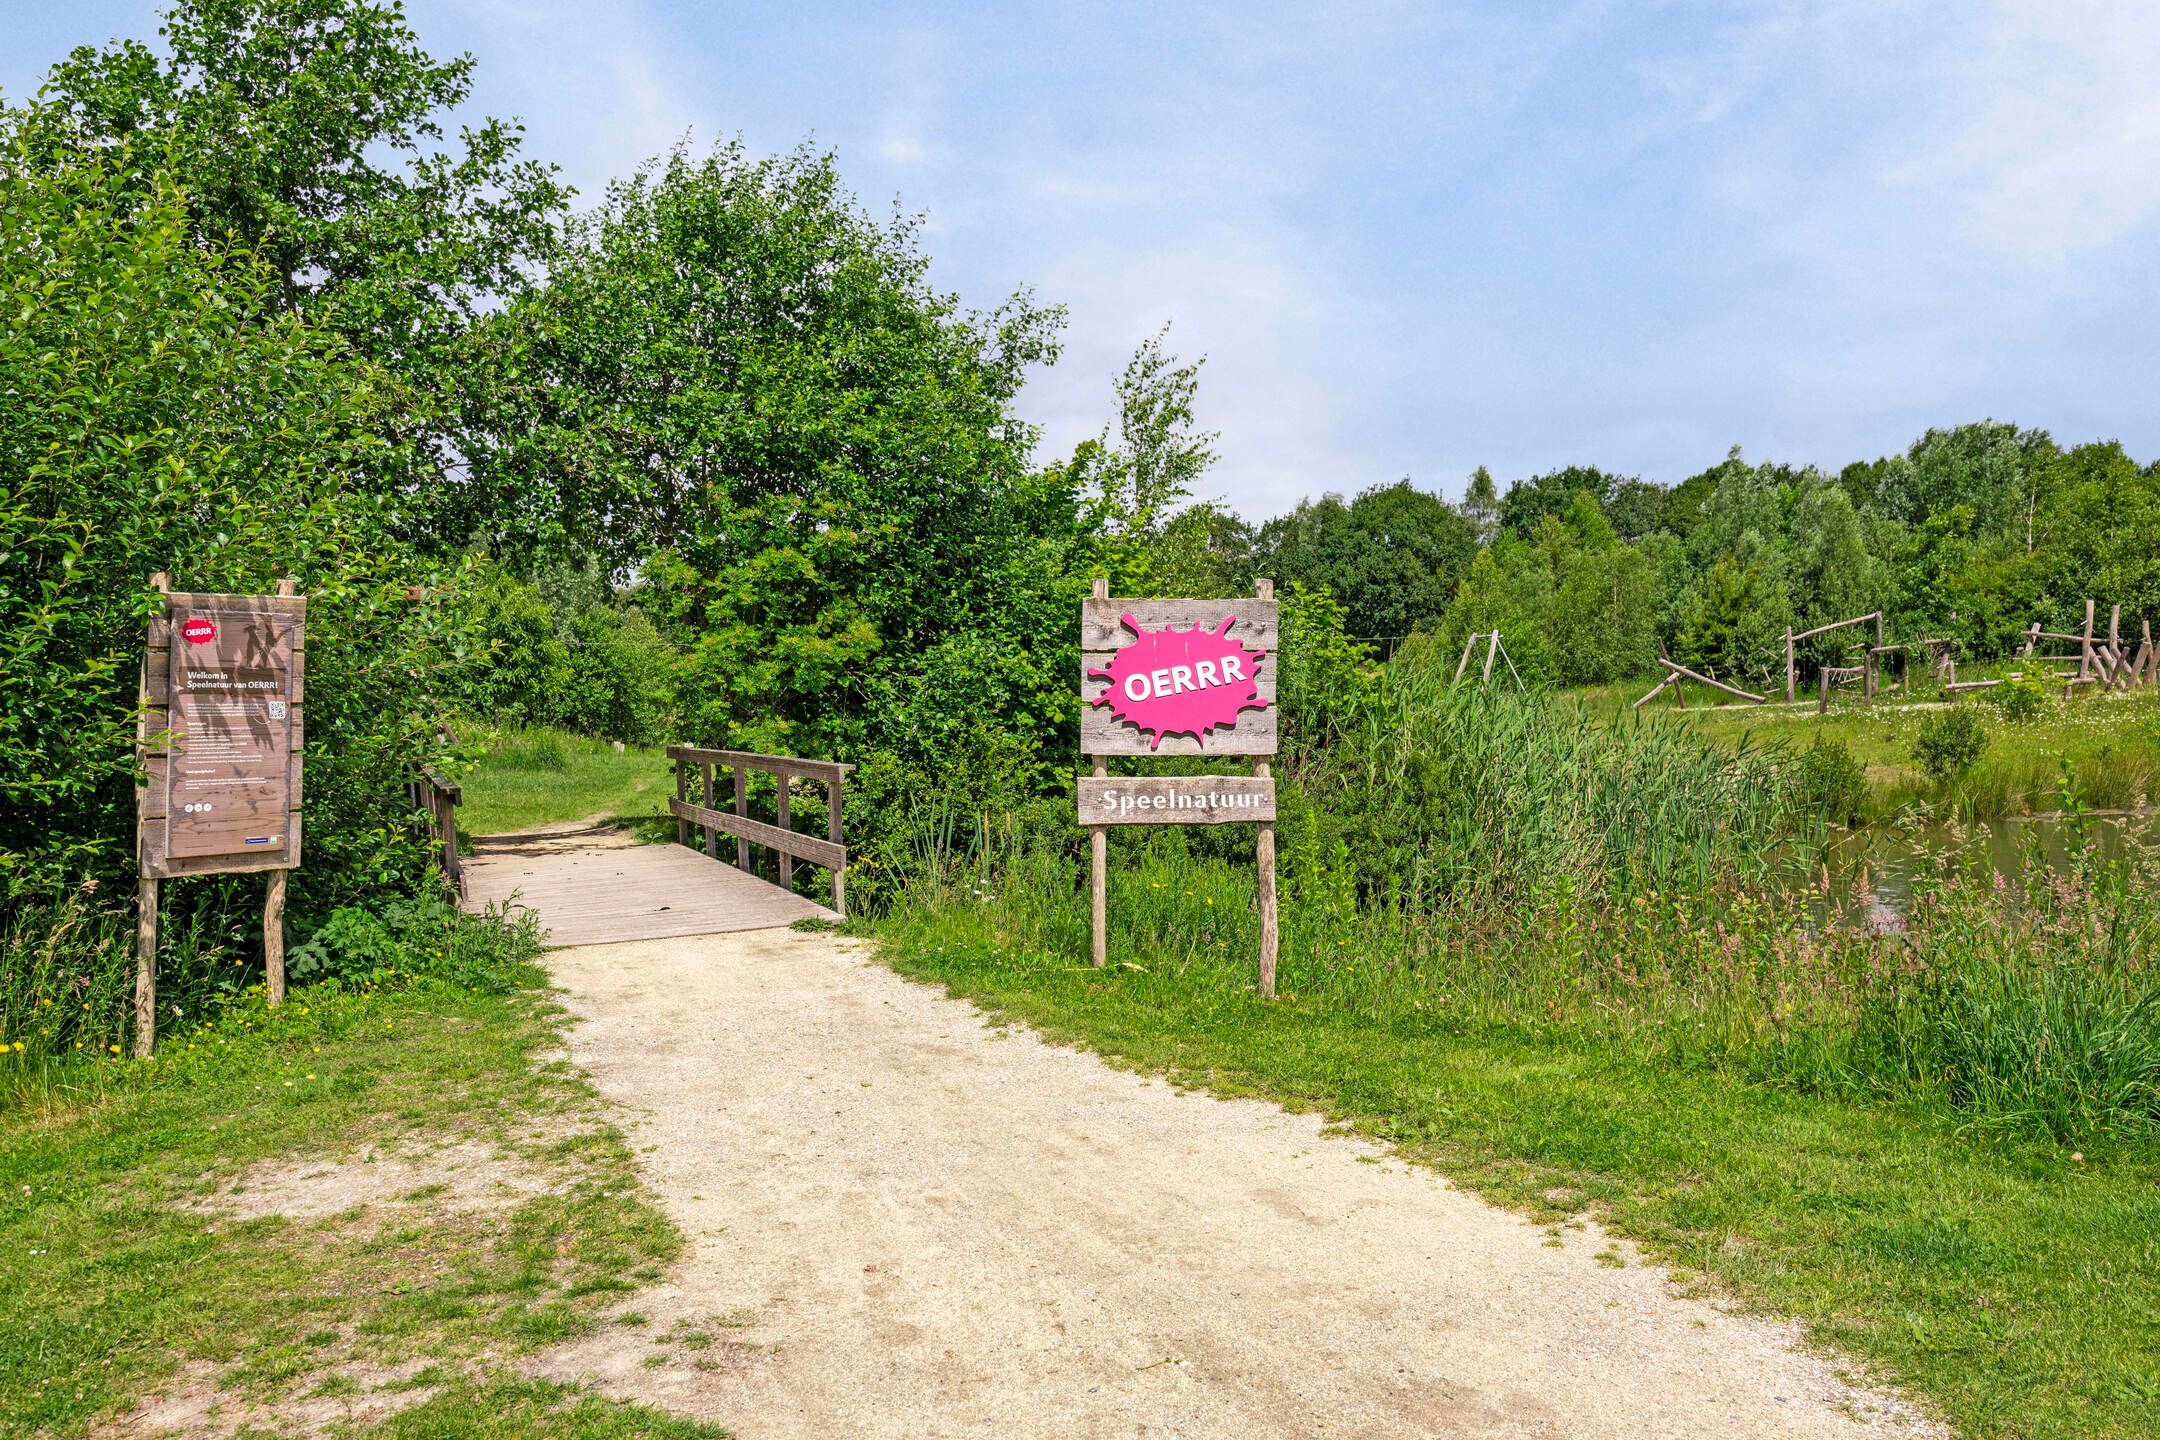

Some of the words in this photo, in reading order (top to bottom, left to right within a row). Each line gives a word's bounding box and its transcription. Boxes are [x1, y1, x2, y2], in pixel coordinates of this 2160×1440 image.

[186, 627, 212, 636] OERRR
[187, 671, 219, 680] Welkom
[221, 671, 228, 680] in
[1124, 655, 1247, 702] OERRR
[187, 680, 232, 690] Speelnatuur
[248, 681, 278, 689] OERRR!
[1103, 789, 1263, 816] Speelnatuur
